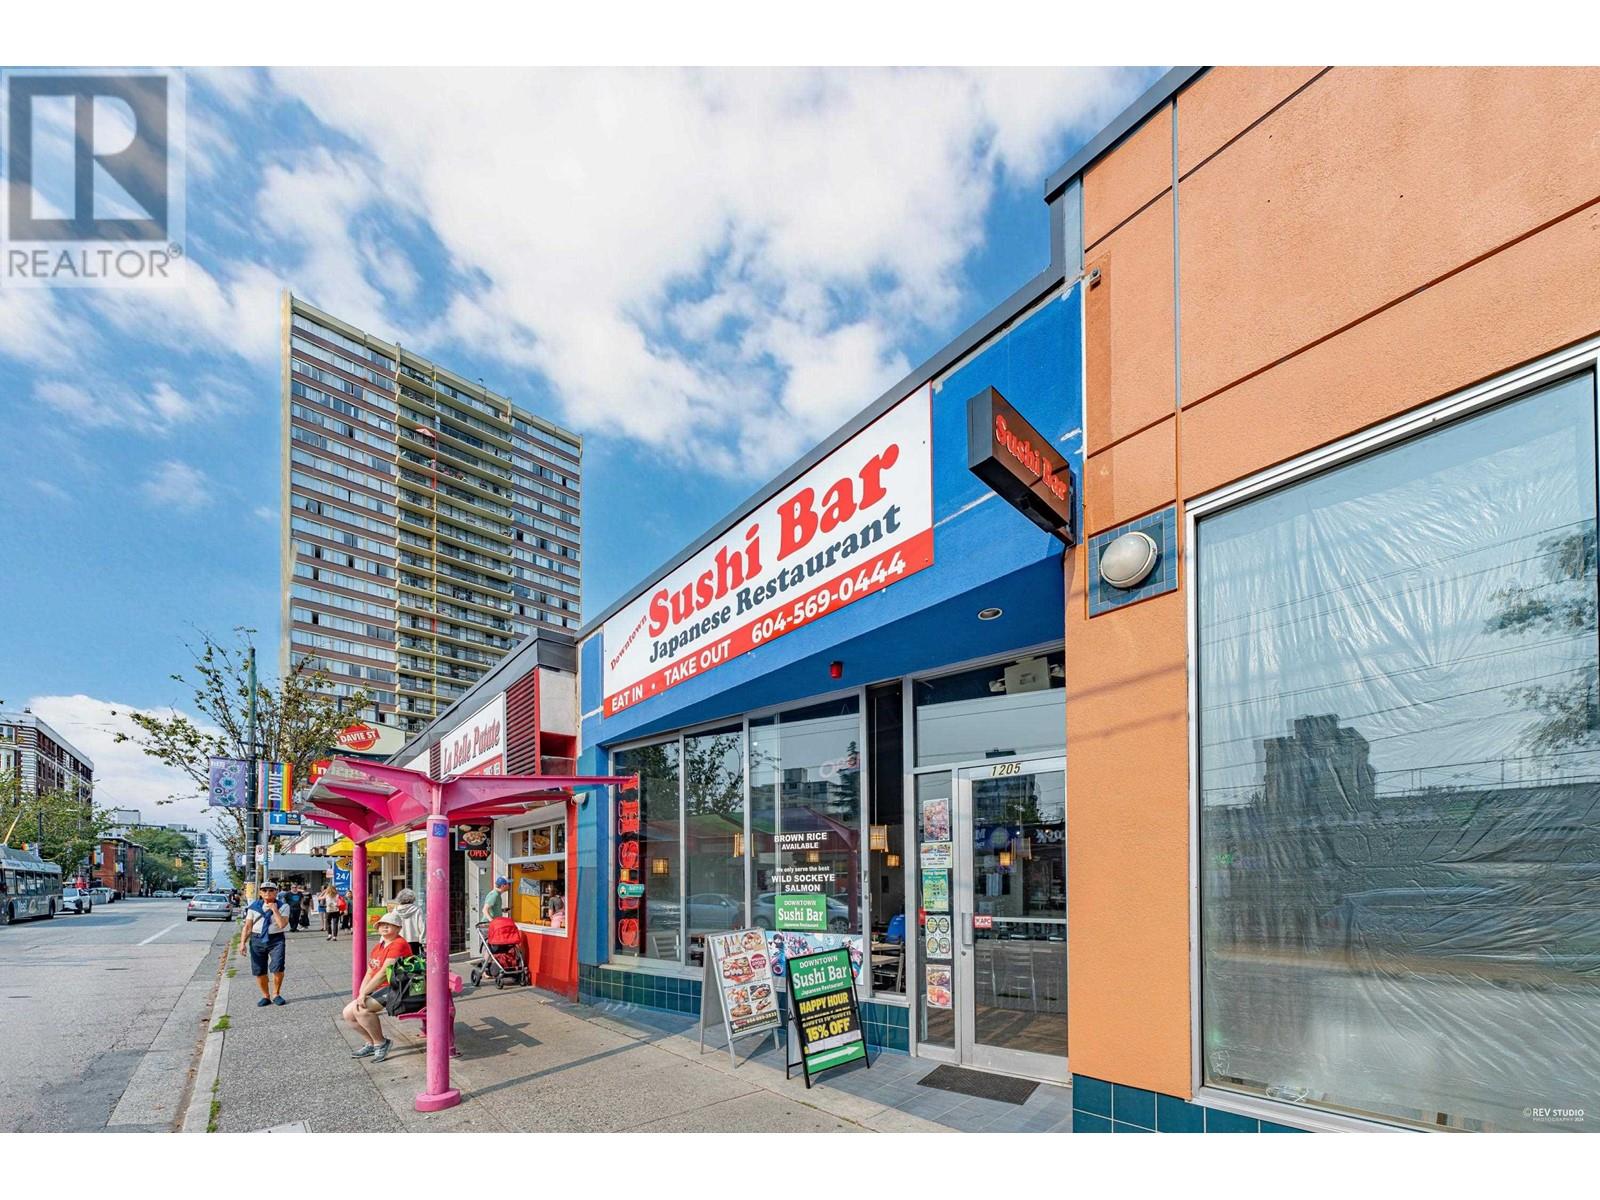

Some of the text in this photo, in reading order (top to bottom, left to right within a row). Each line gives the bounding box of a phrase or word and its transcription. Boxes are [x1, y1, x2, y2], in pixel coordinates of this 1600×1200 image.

[995, 415, 1040, 477] Sushi
[648, 443, 900, 638] Sushi Bar
[649, 504, 901, 663] Japanese Restaurant
[611, 551, 906, 712] EAT IN TAKE OUT 604-569-0444
[610, 614, 647, 670] Downtown
[340, 731, 366, 743] DAVIE
[453, 733, 472, 770] Belle
[990, 762, 1021, 777] 1205
[269, 770, 283, 801] DAVIE
[774, 832, 828, 843] BROWN RICE
[781, 842, 820, 850] AVAILABLE
[470, 850, 488, 858] OPEN
[783, 866, 794, 874] only
[771, 873, 836, 883] WILD SOCKEYE
[785, 884, 821, 893] SALMON
[778, 907, 824, 921] Sushi Bar
[799, 955, 838, 969] DOWNTOWN
[792, 967, 826, 989] Sushi
[827, 964, 847, 980] Bar
[801, 981, 845, 996] Japanese Restaurant
[799, 994, 828, 1014] HAPPY
[827, 992, 849, 1007] HOUR
[806, 1024, 830, 1042] 15%
[829, 1018, 850, 1035] OFF
